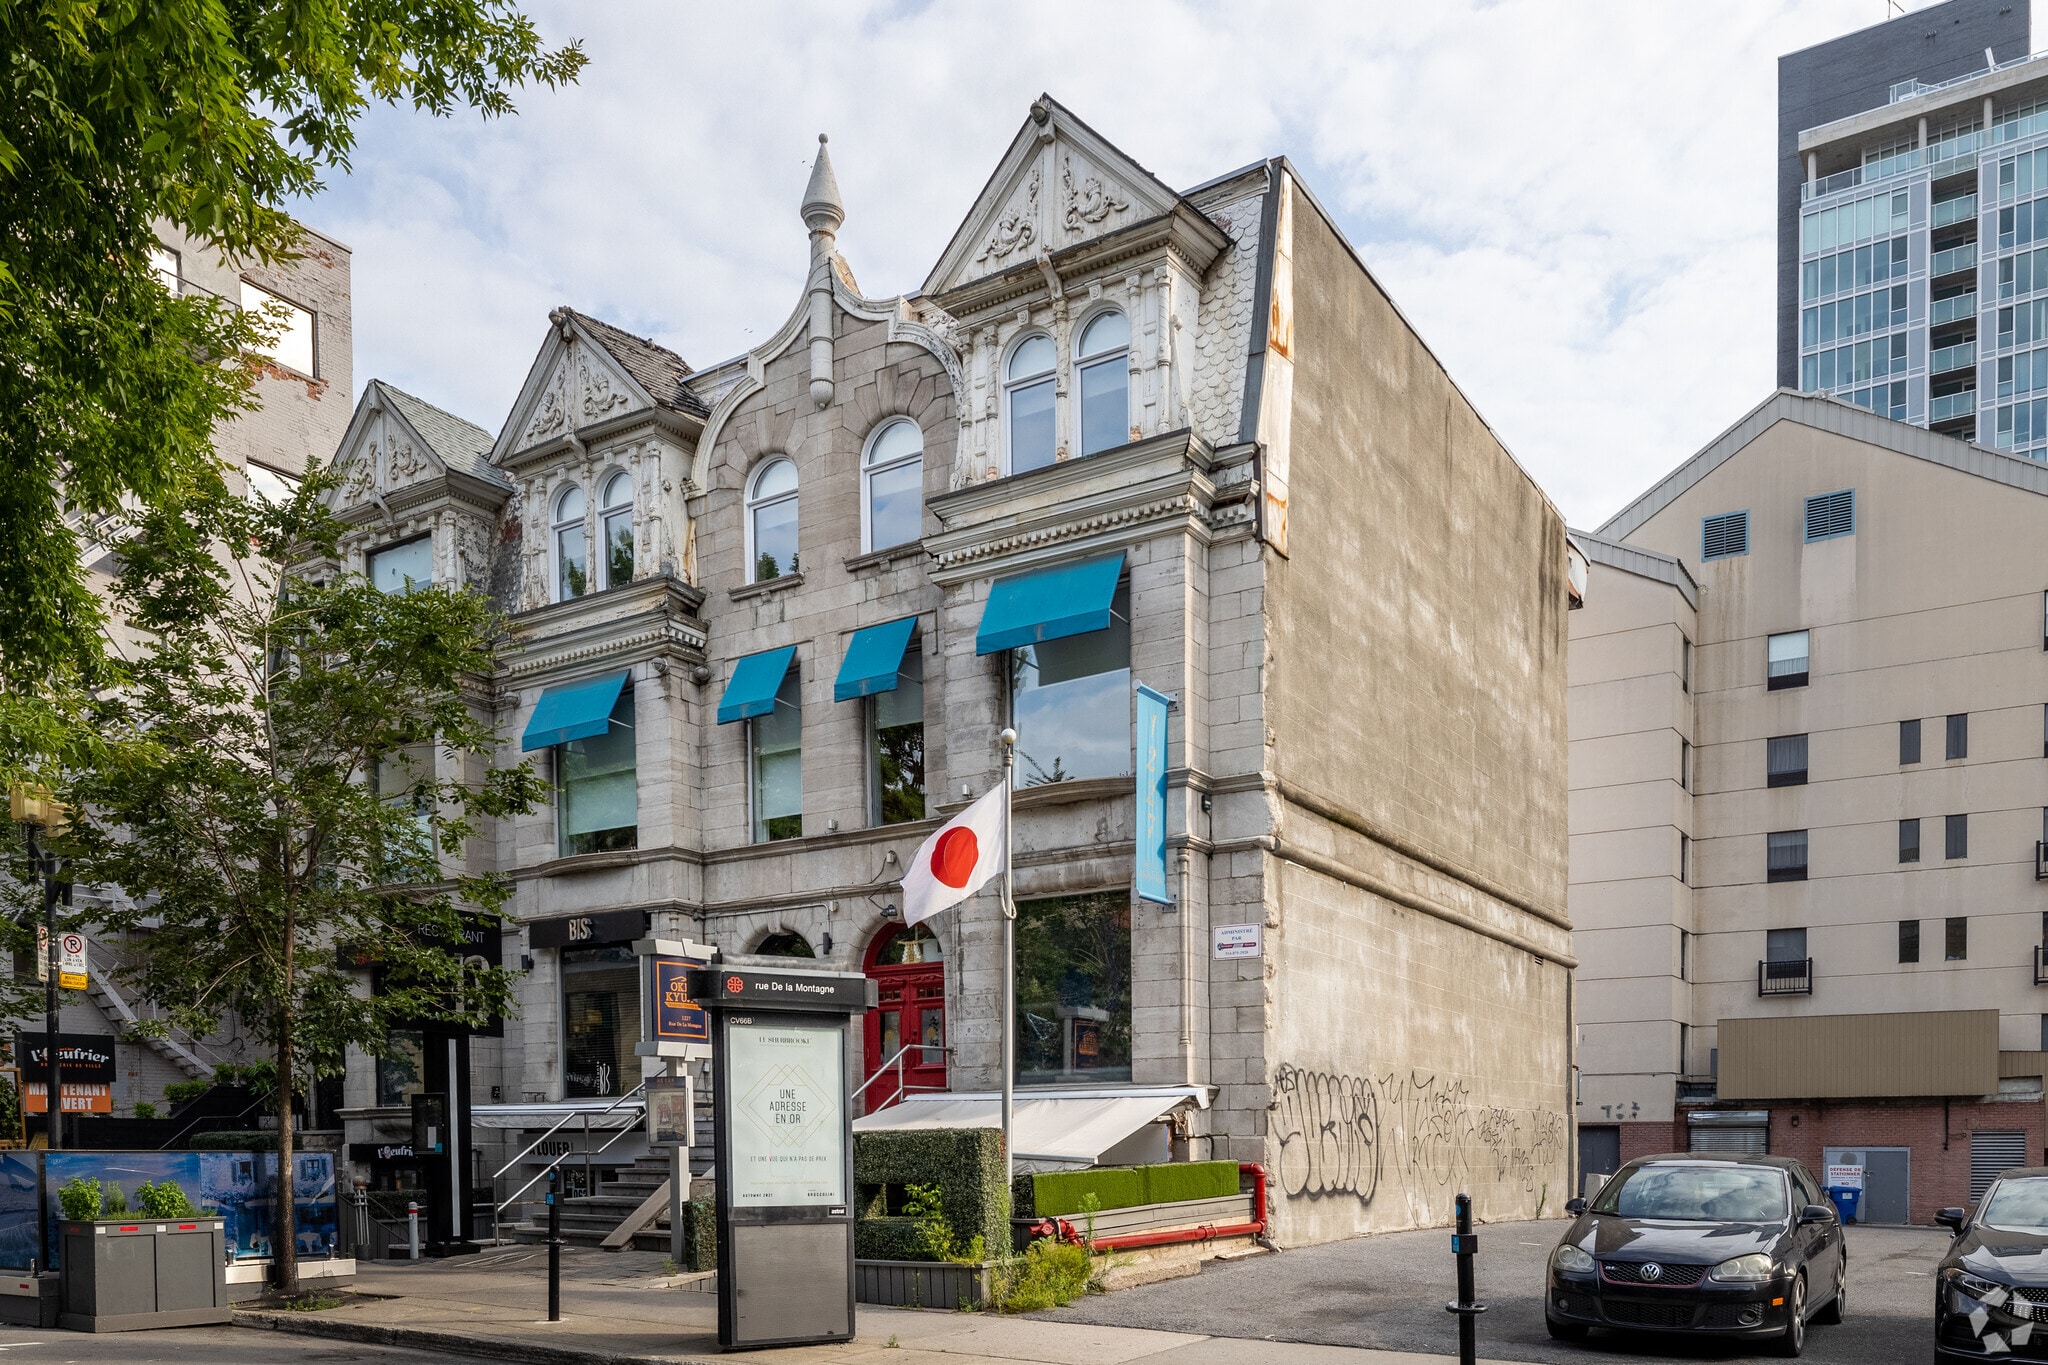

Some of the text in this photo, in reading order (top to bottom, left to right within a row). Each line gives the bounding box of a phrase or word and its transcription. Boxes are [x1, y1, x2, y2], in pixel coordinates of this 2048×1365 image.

[568, 918, 590, 940] BIS
[755, 981, 835, 995] rue De la Montagne
[730, 1016, 752, 1025] CV66B
[28, 1082, 107, 1096] MATENANT
[779, 1088, 796, 1099] UNE
[45, 1097, 93, 1110] VERT
[769, 1101, 807, 1112] ADRESSE
[775, 1113, 801, 1124] EN OR
[780, 1155, 789, 1163] QUI
